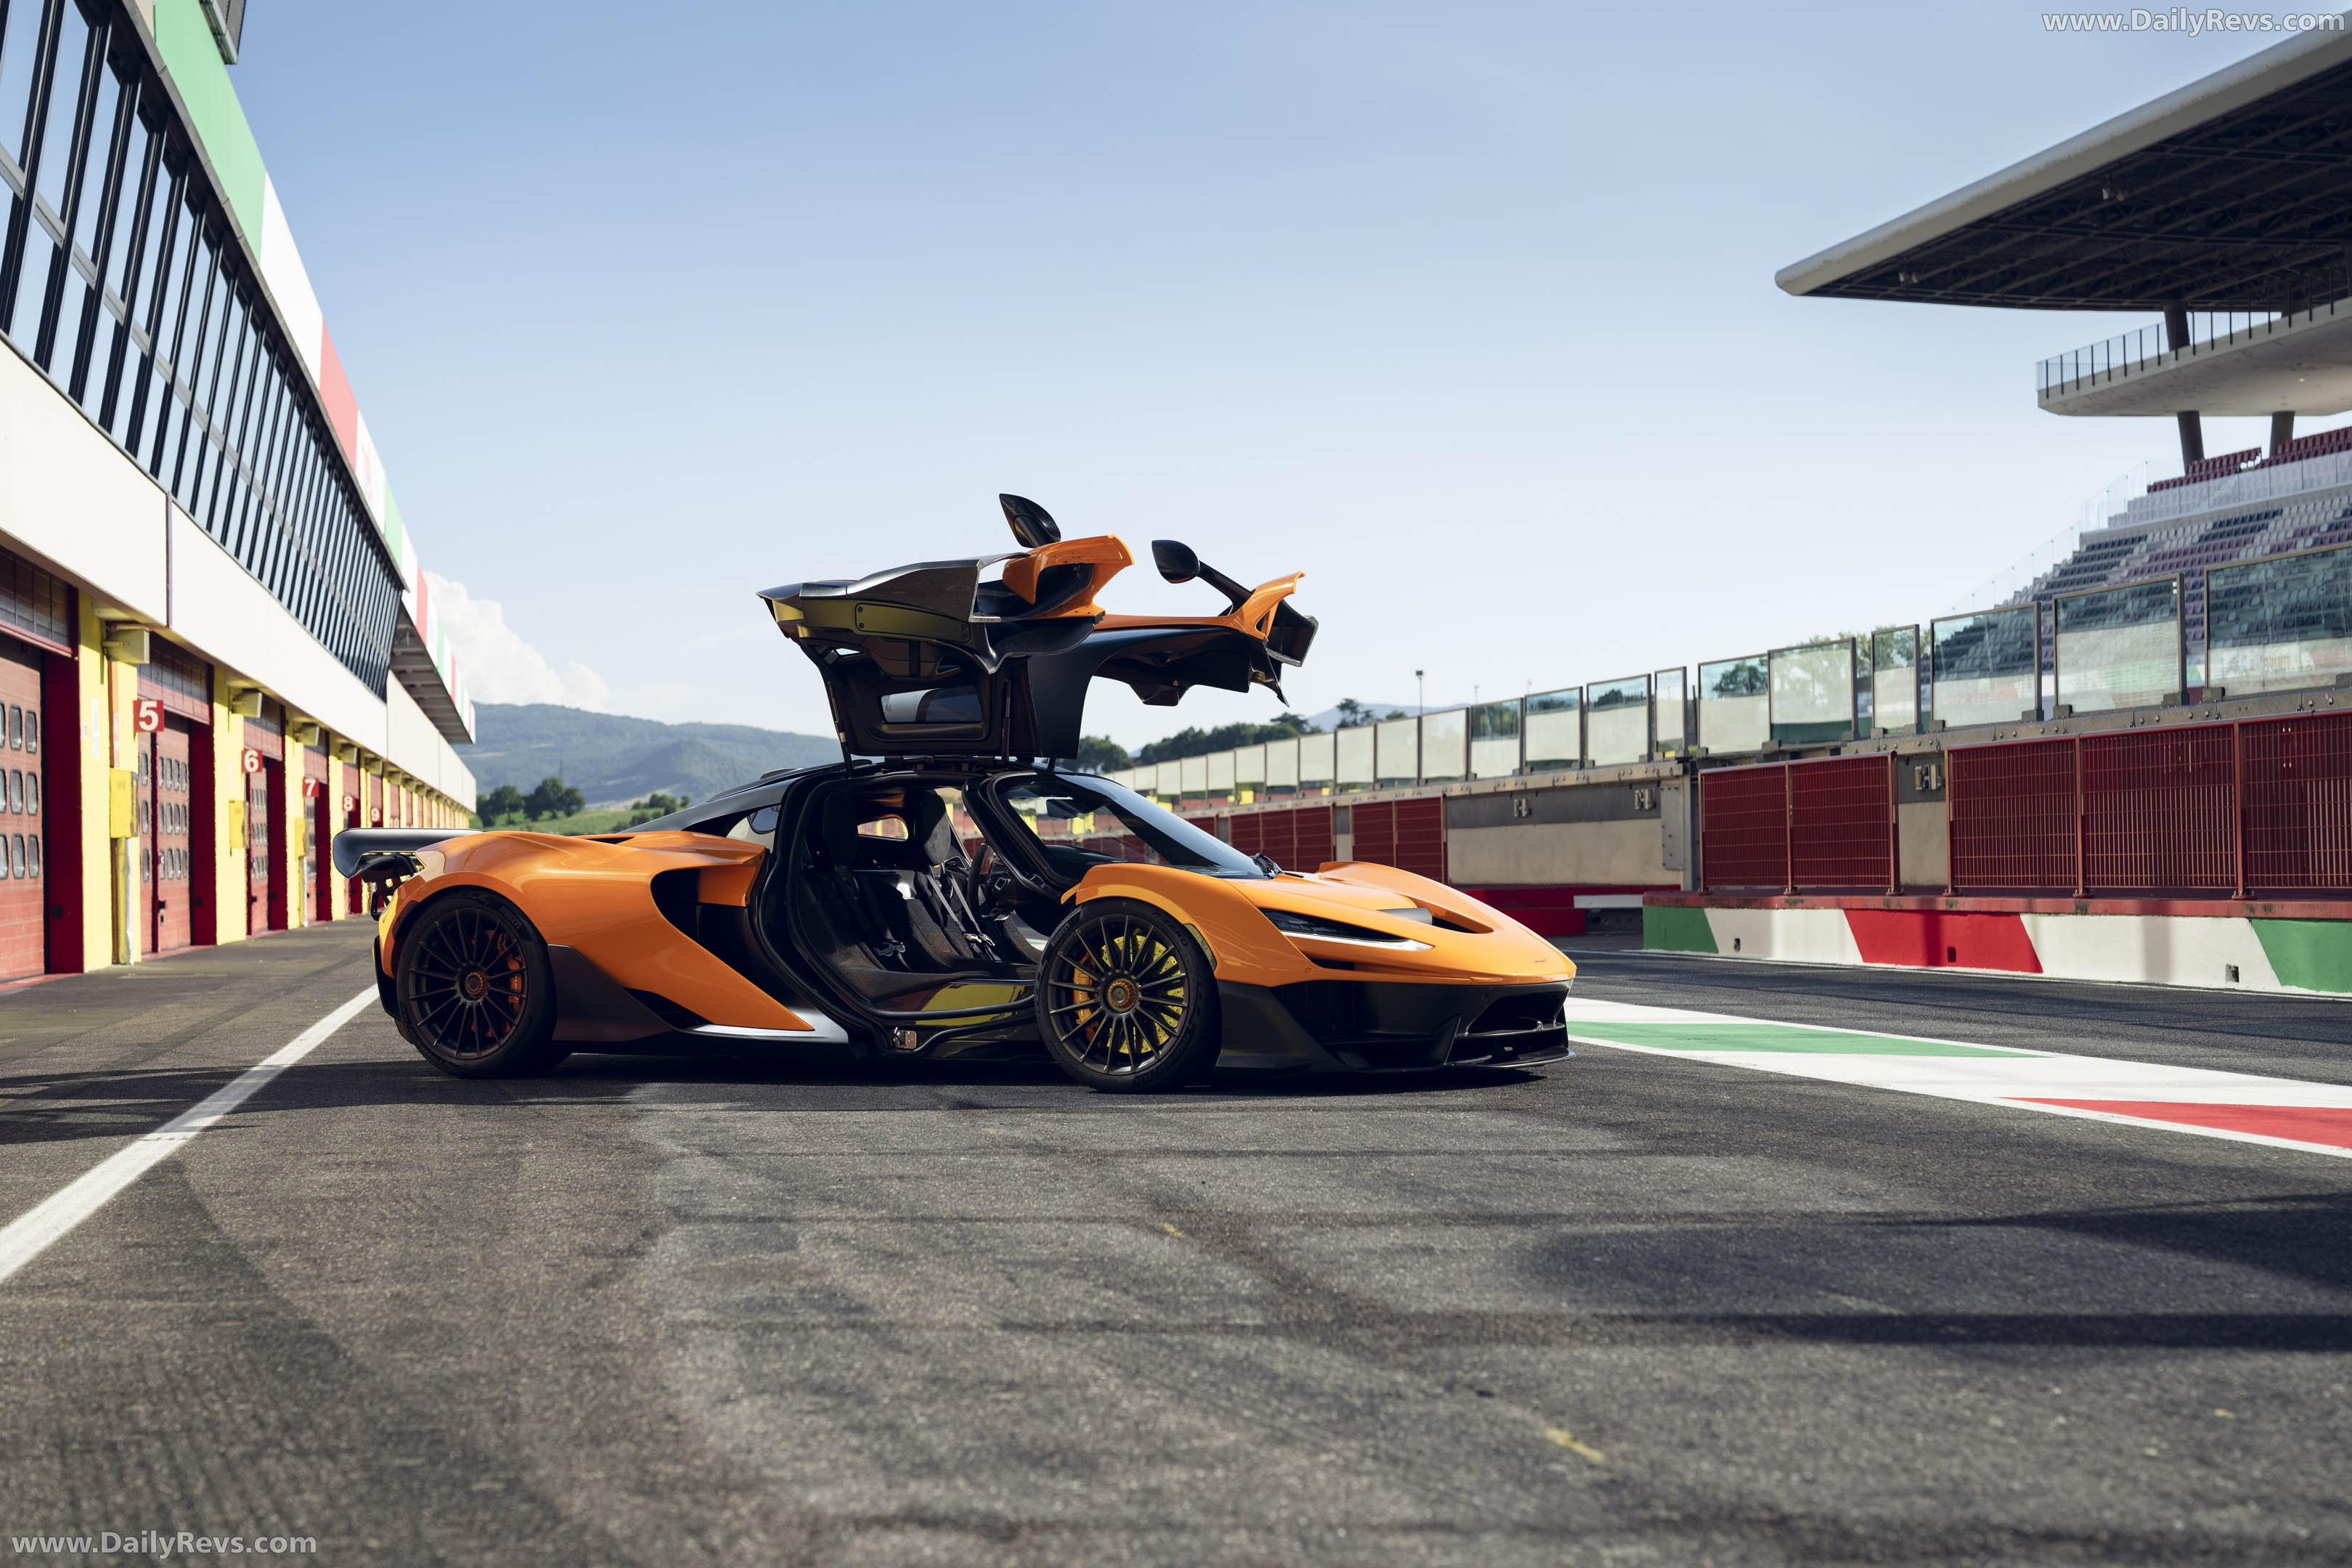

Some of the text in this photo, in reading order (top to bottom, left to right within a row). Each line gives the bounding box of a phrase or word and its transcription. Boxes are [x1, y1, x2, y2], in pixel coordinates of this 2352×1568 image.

[139, 701, 159, 730] 5
[244, 750, 259, 772] 6
[304, 780, 316, 796] 7
[343, 796, 353, 811] 8
[371, 807, 380, 822] 9
